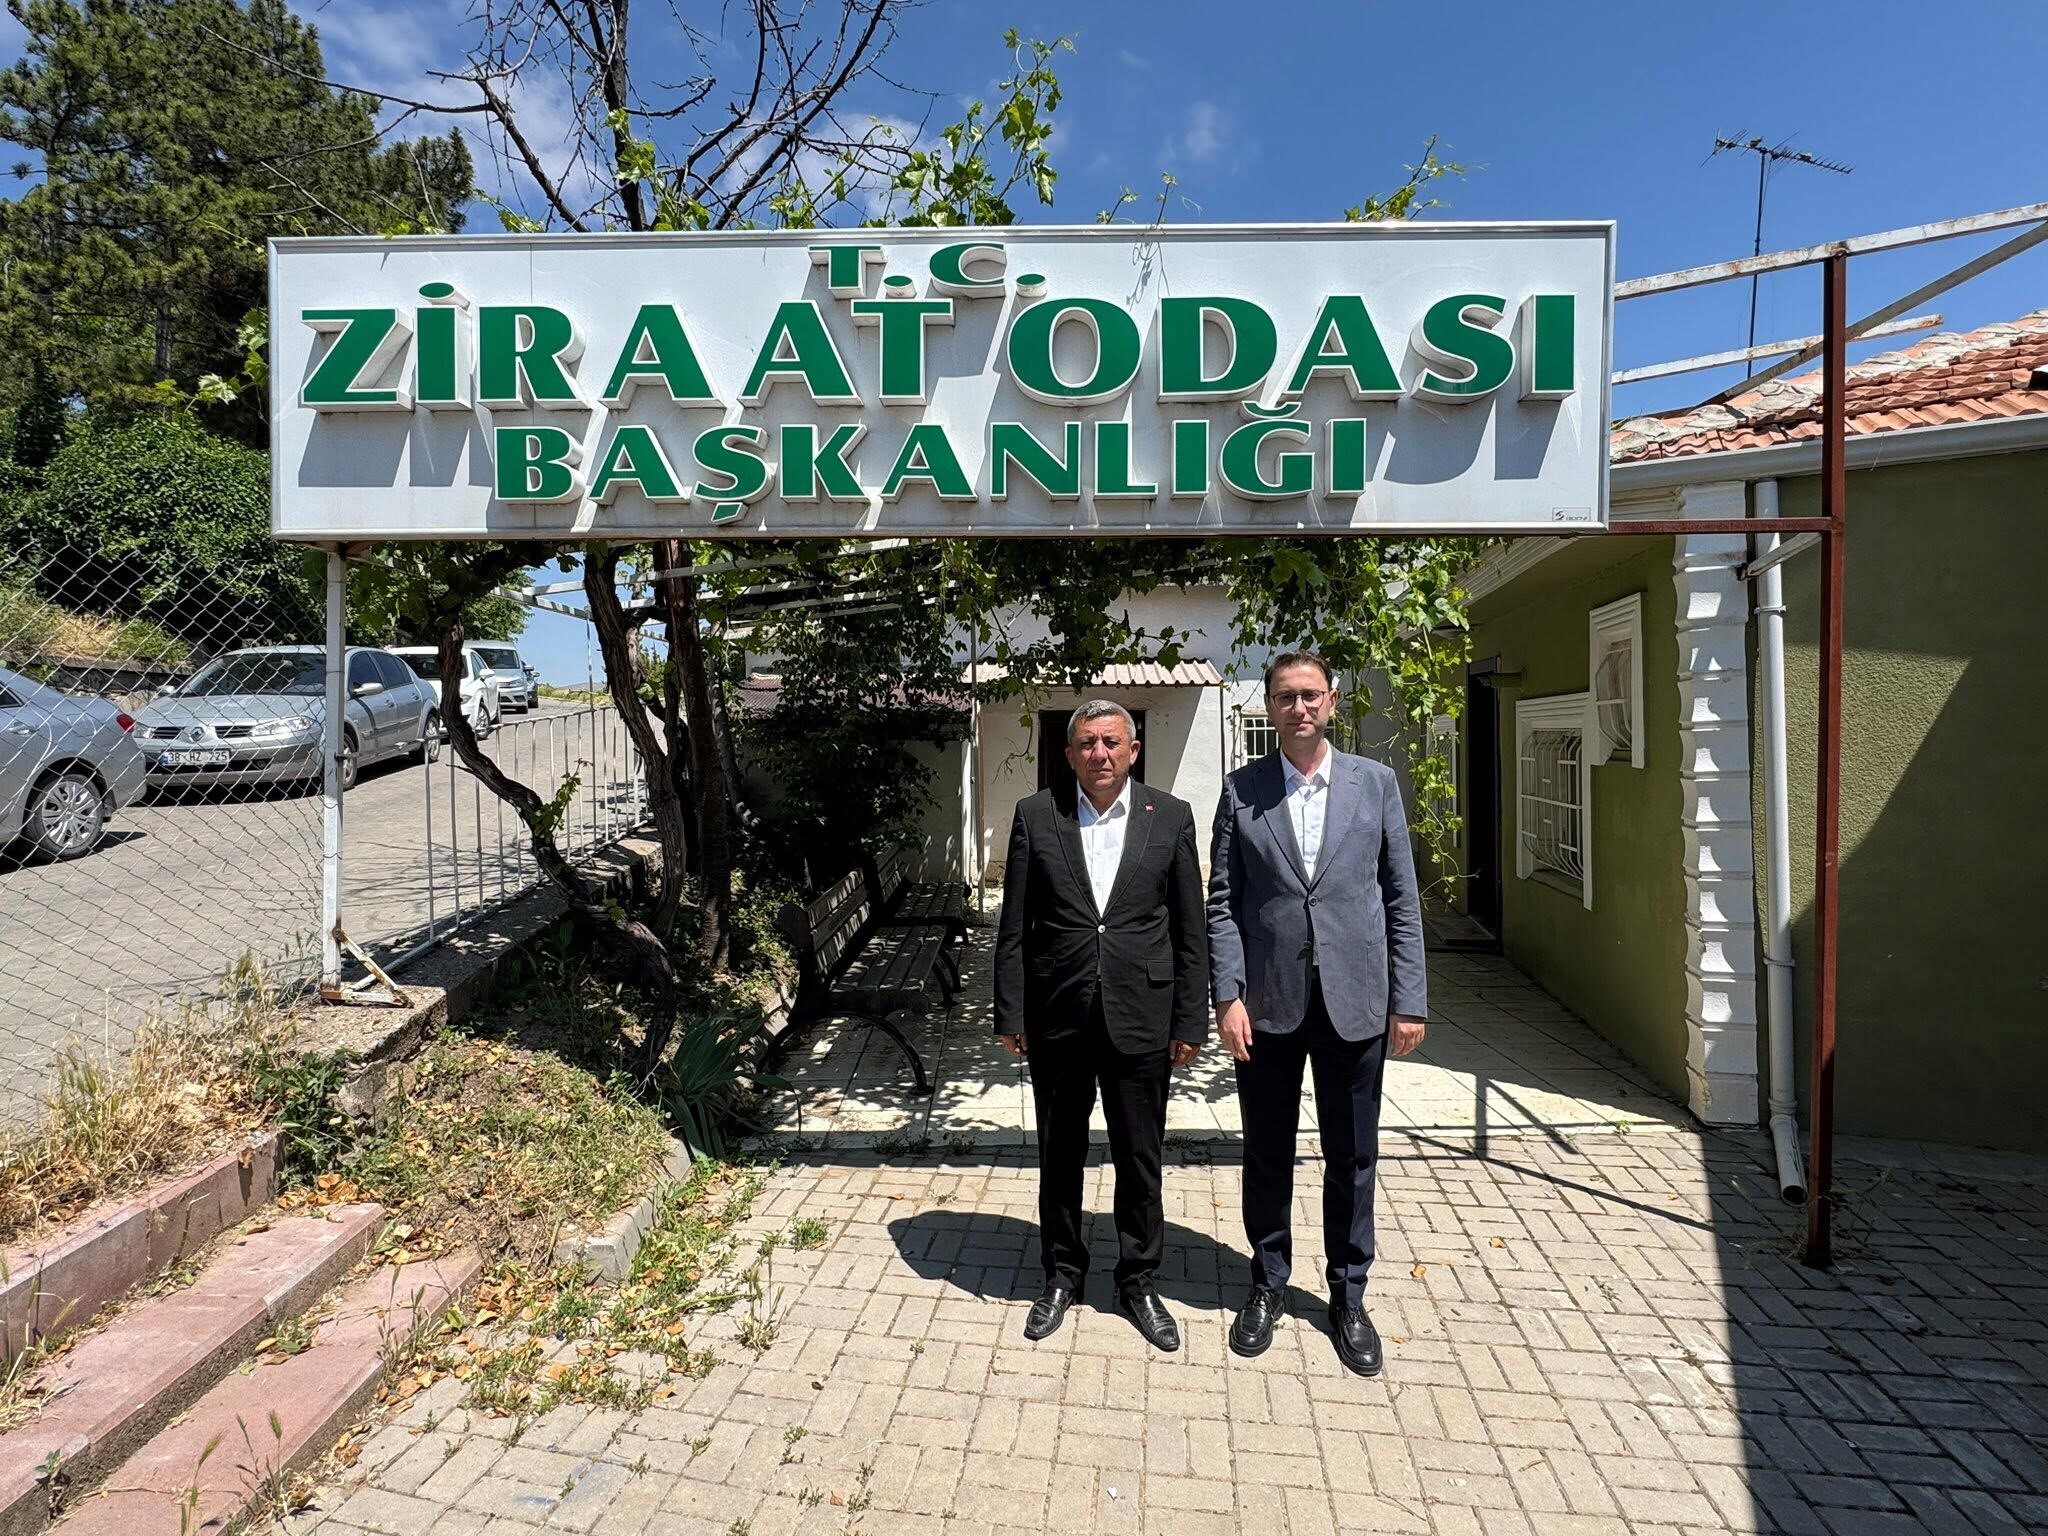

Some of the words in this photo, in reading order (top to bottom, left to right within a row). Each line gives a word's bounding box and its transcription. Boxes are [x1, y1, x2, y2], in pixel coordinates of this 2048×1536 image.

[807, 241, 1047, 288] T.C.
[300, 281, 953, 403] ZİRAAT
[1008, 294, 1577, 396] ODASI
[494, 401, 1367, 522] BAŞKANLIĞI
[168, 752, 181, 762] 38
